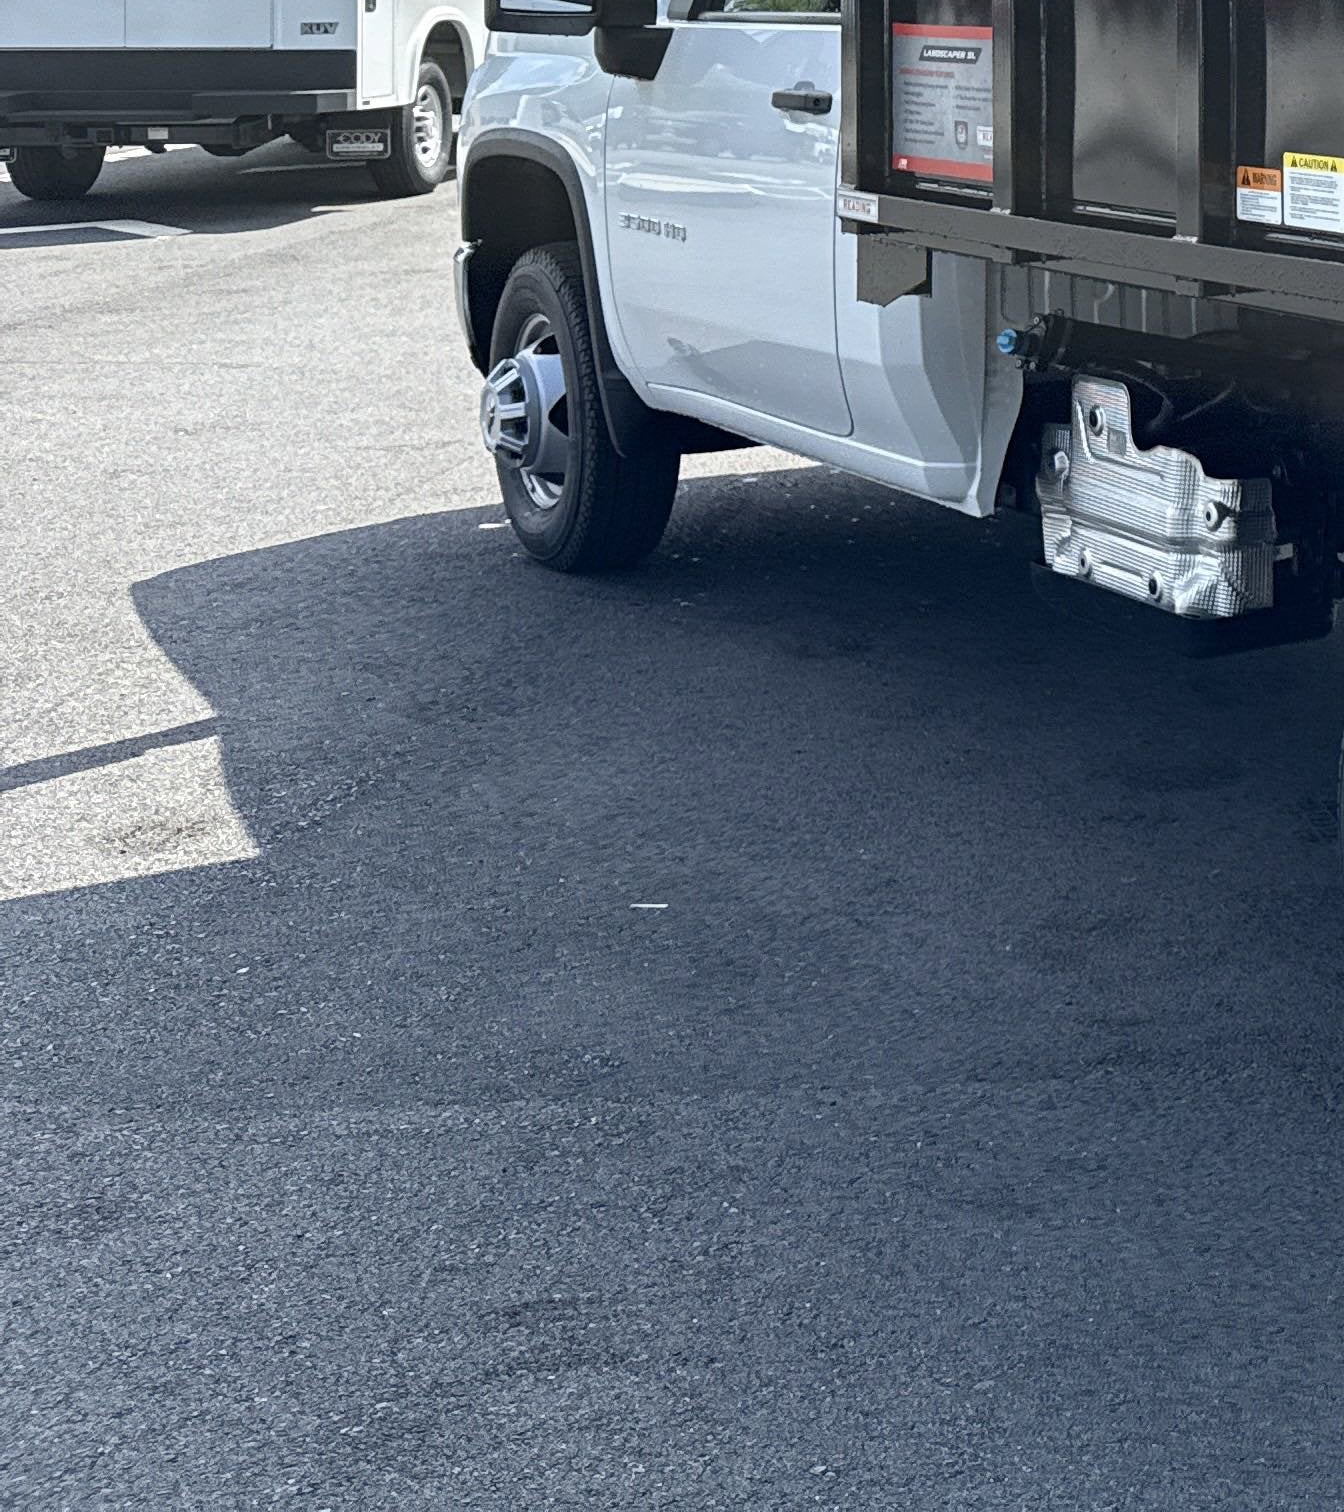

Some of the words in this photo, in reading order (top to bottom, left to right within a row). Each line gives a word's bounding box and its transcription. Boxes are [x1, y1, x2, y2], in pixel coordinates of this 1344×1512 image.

[300, 22, 339, 35] XUV
[1298, 157, 1329, 170] CAUTION
[1252, 172, 1278, 186] WARNING
